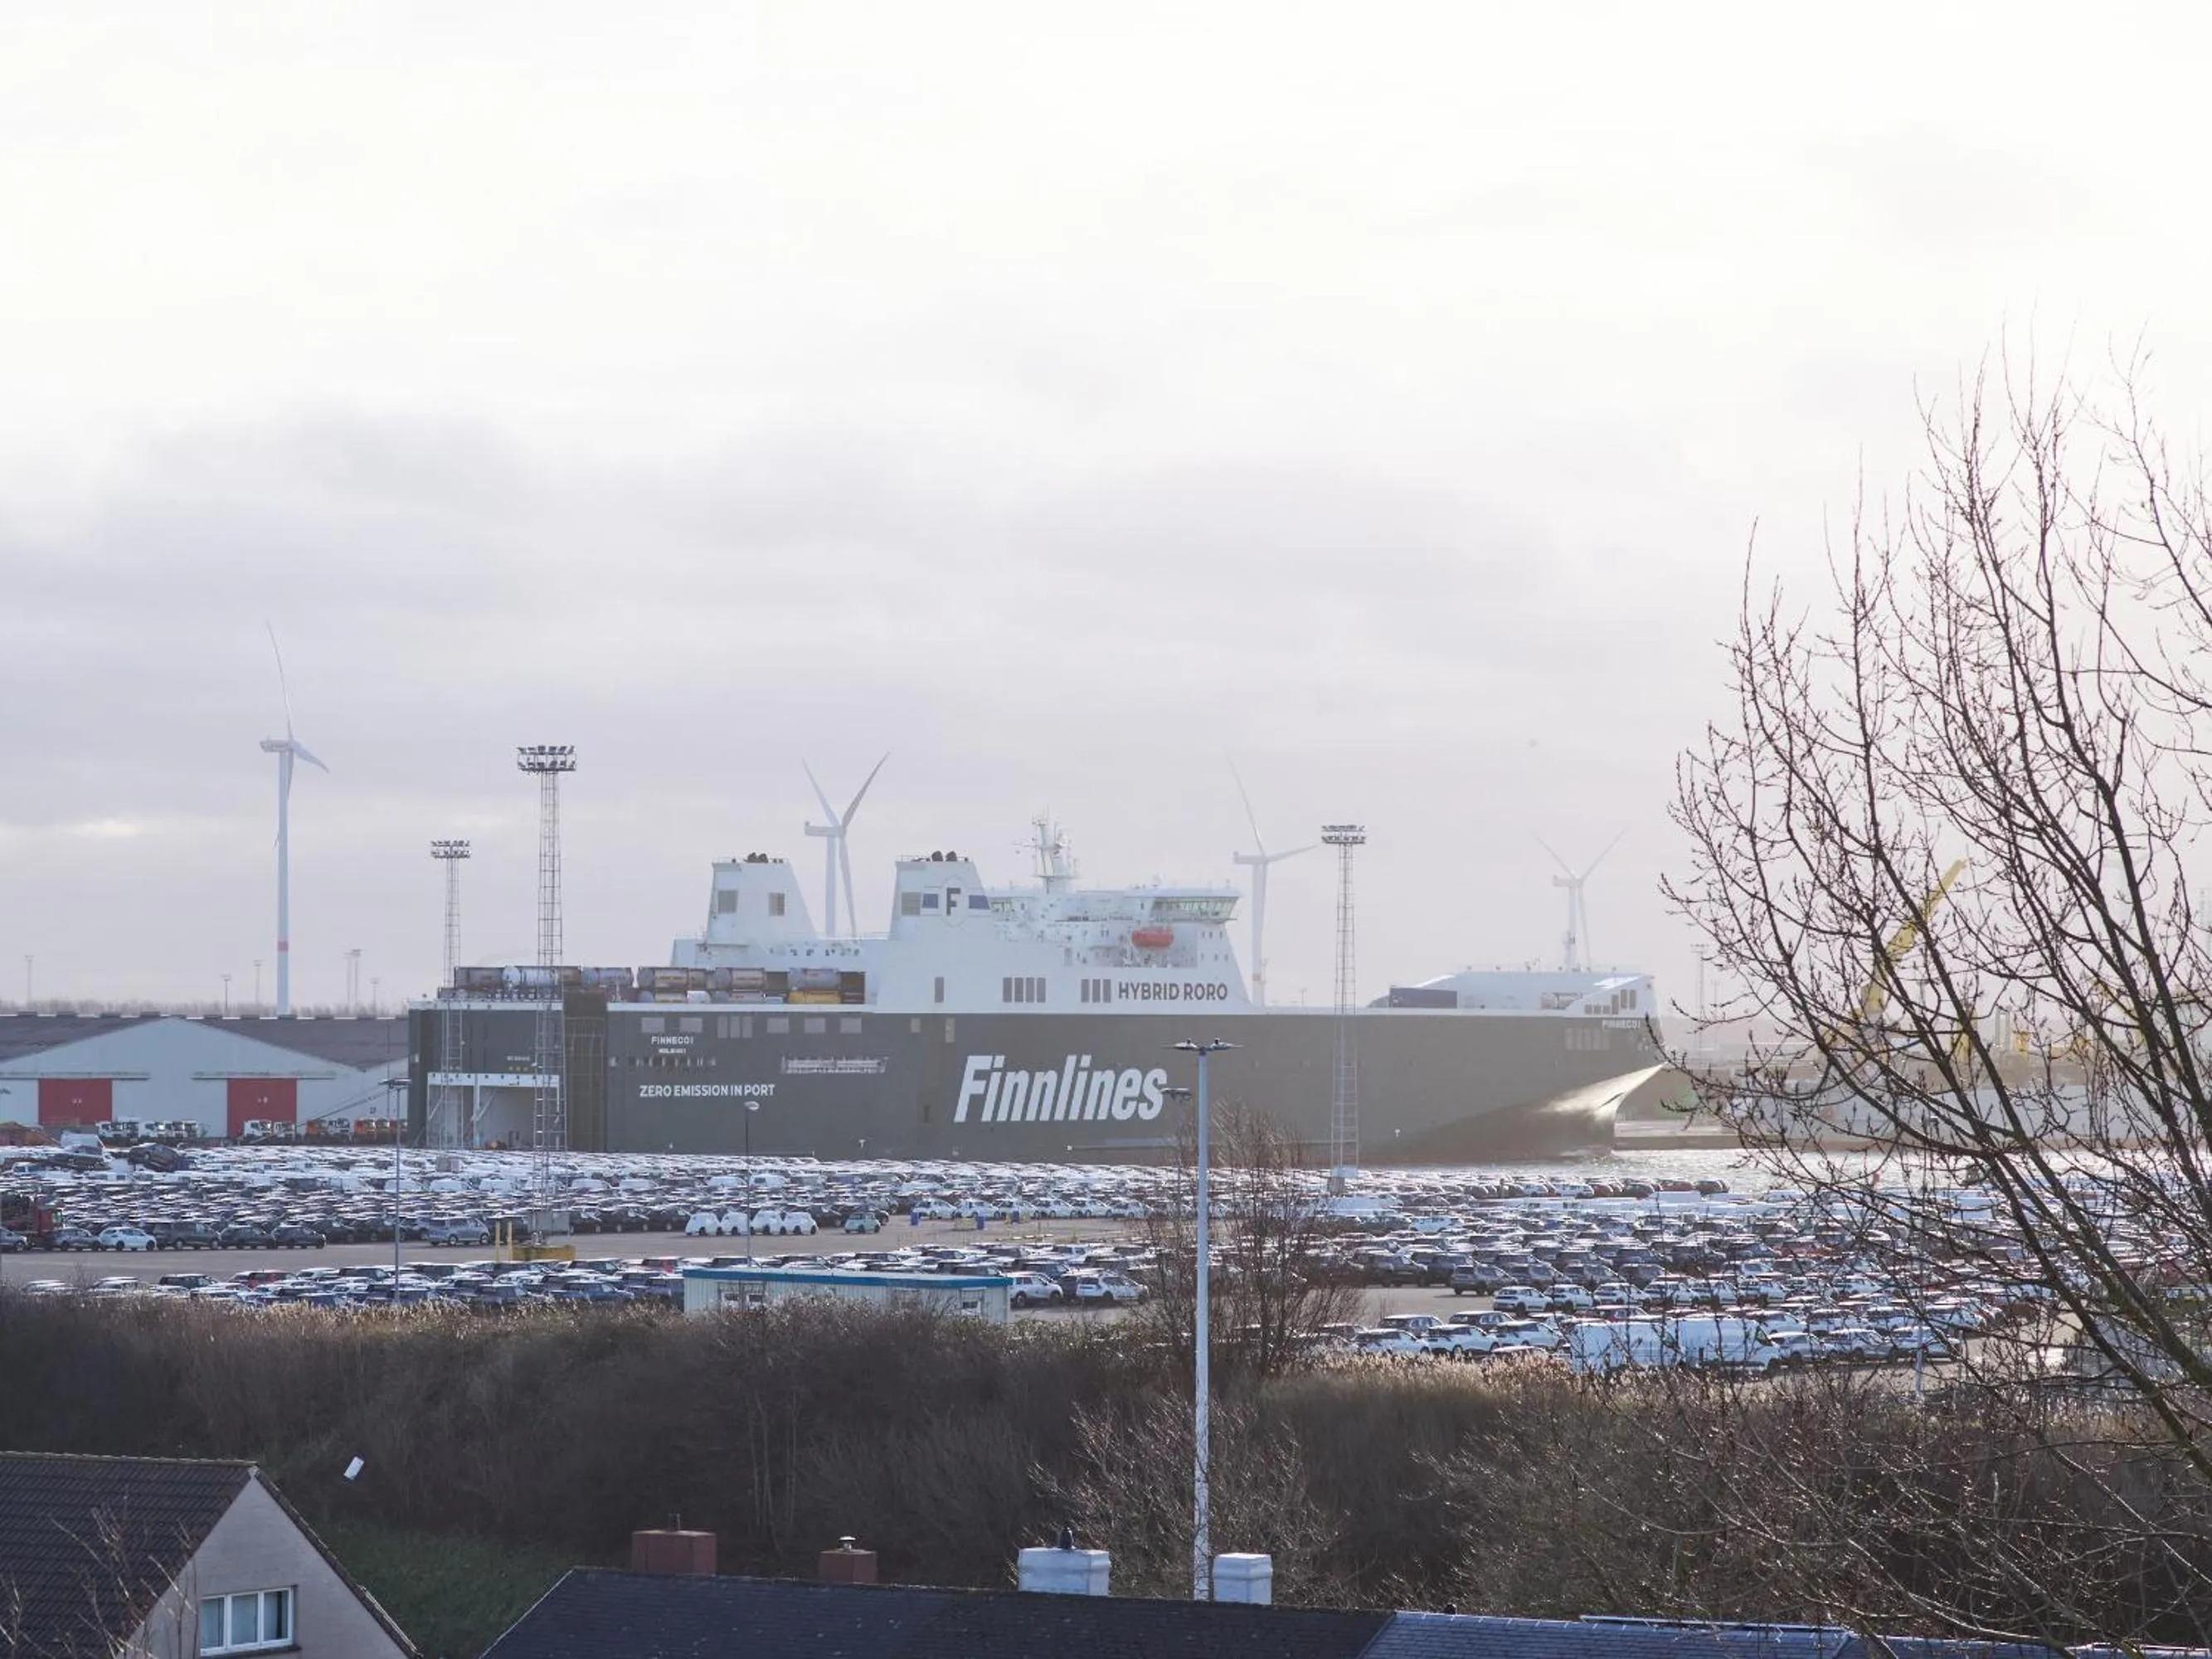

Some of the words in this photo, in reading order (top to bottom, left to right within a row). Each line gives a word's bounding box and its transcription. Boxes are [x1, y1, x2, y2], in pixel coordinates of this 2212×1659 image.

[946, 888, 961, 916] F
[1118, 981, 1179, 1000] HYBRID
[1184, 982, 1228, 1000] RORO
[639, 1084, 672, 1097] ZERO
[673, 1084, 729, 1097] EMISSION
[731, 1084, 743, 1096] IN
[744, 1083, 775, 1096] PORT
[954, 1054, 1168, 1122] Finnlines
